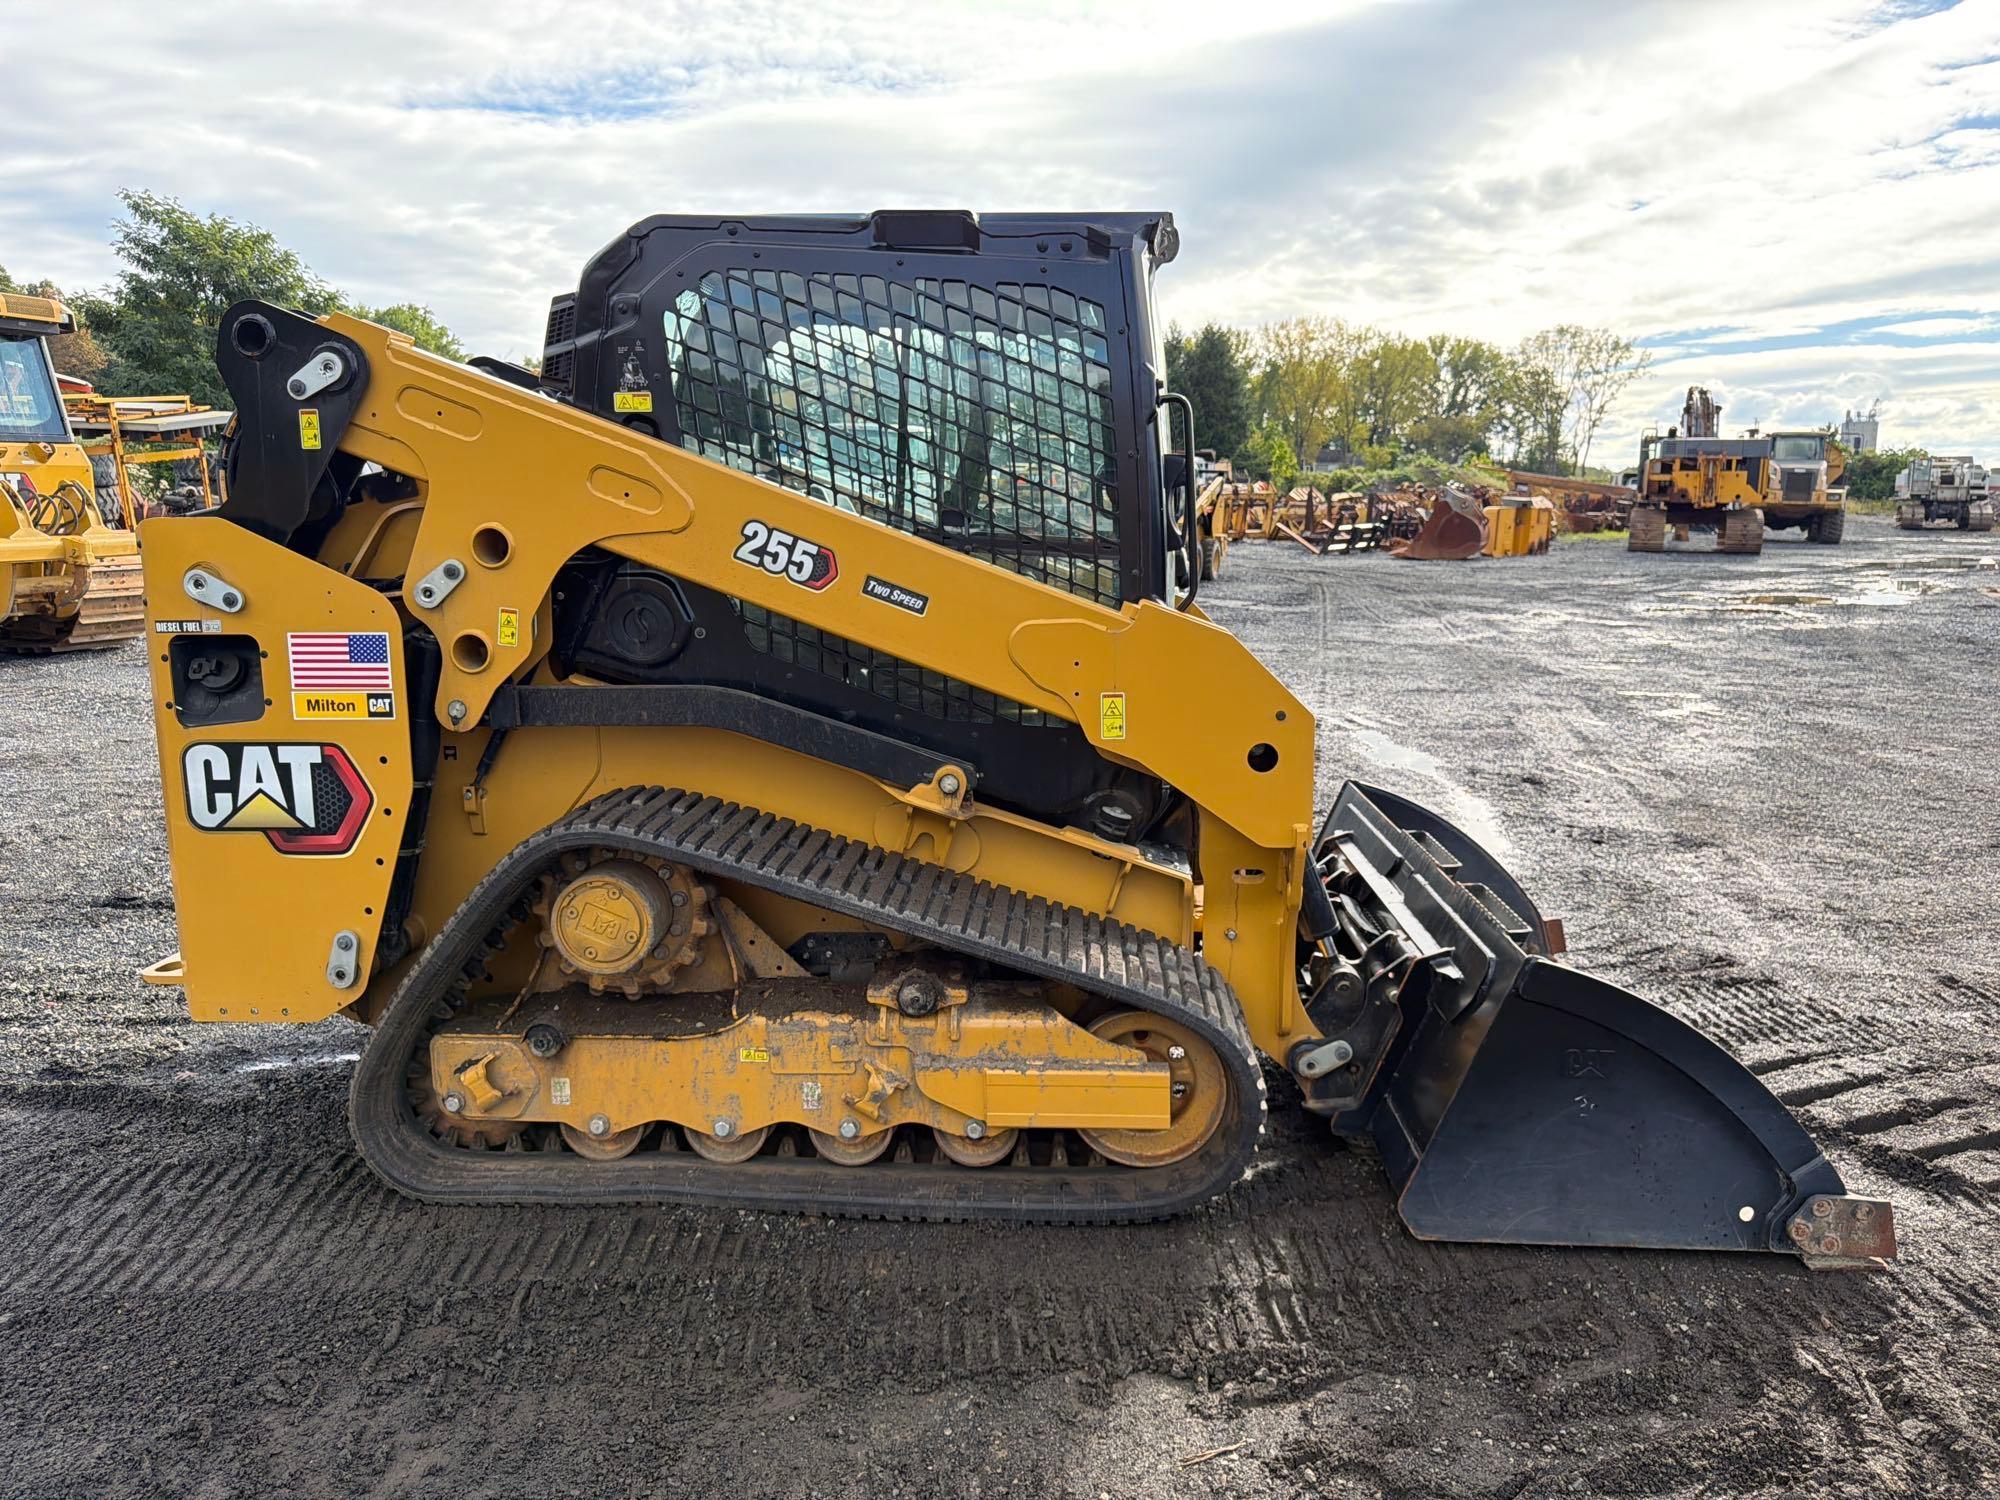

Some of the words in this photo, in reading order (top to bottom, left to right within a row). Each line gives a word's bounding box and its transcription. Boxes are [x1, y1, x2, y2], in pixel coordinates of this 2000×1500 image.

[736, 521, 819, 582] 255
[156, 622, 181, 632] DIESEL
[183, 622, 201, 632] FUEL
[306, 698, 356, 712] Milton
[369, 698, 391, 713] CAT
[185, 744, 322, 828] CAT
